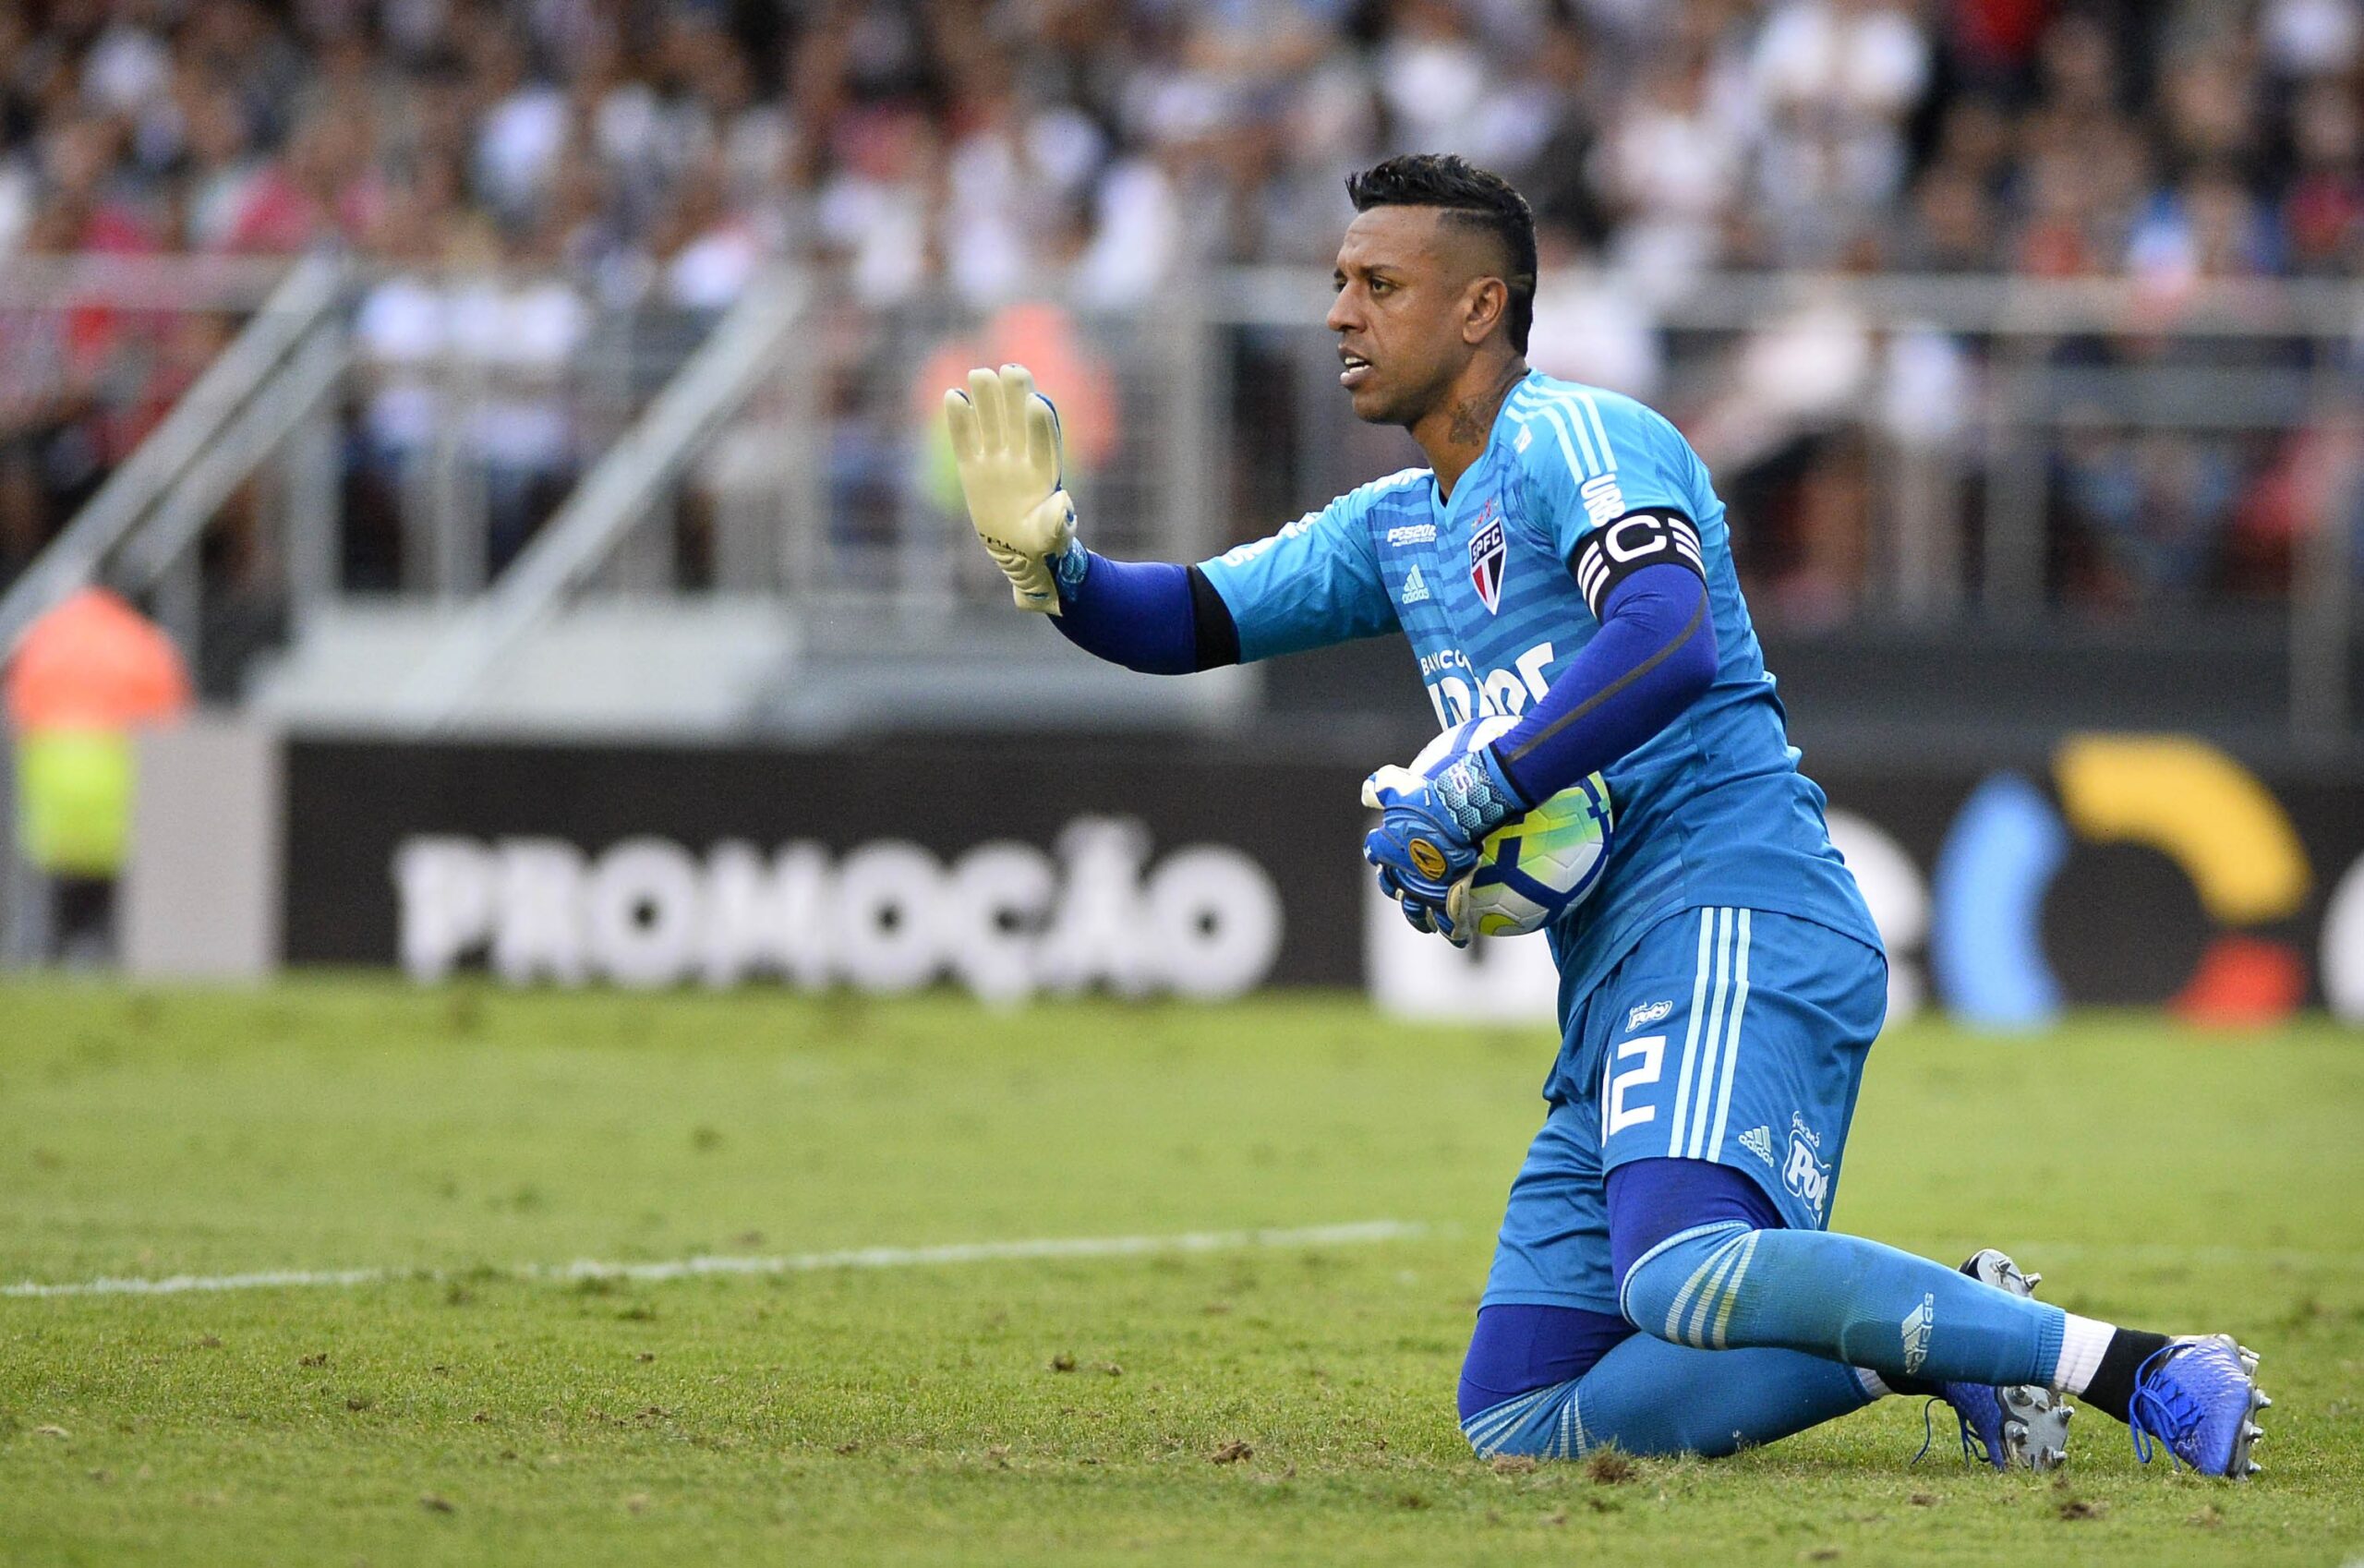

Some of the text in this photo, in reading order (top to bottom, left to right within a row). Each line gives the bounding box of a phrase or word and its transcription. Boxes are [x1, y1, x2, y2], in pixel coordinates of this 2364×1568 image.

[1472, 527, 1501, 563] SPFC
[1605, 514, 1667, 562] C
[1402, 586, 1429, 605] adidas
[397, 816, 1284, 1012] PROMOÇÃO
[1738, 1134, 1775, 1167] adidas
[1906, 1292, 1935, 1374] adidas
